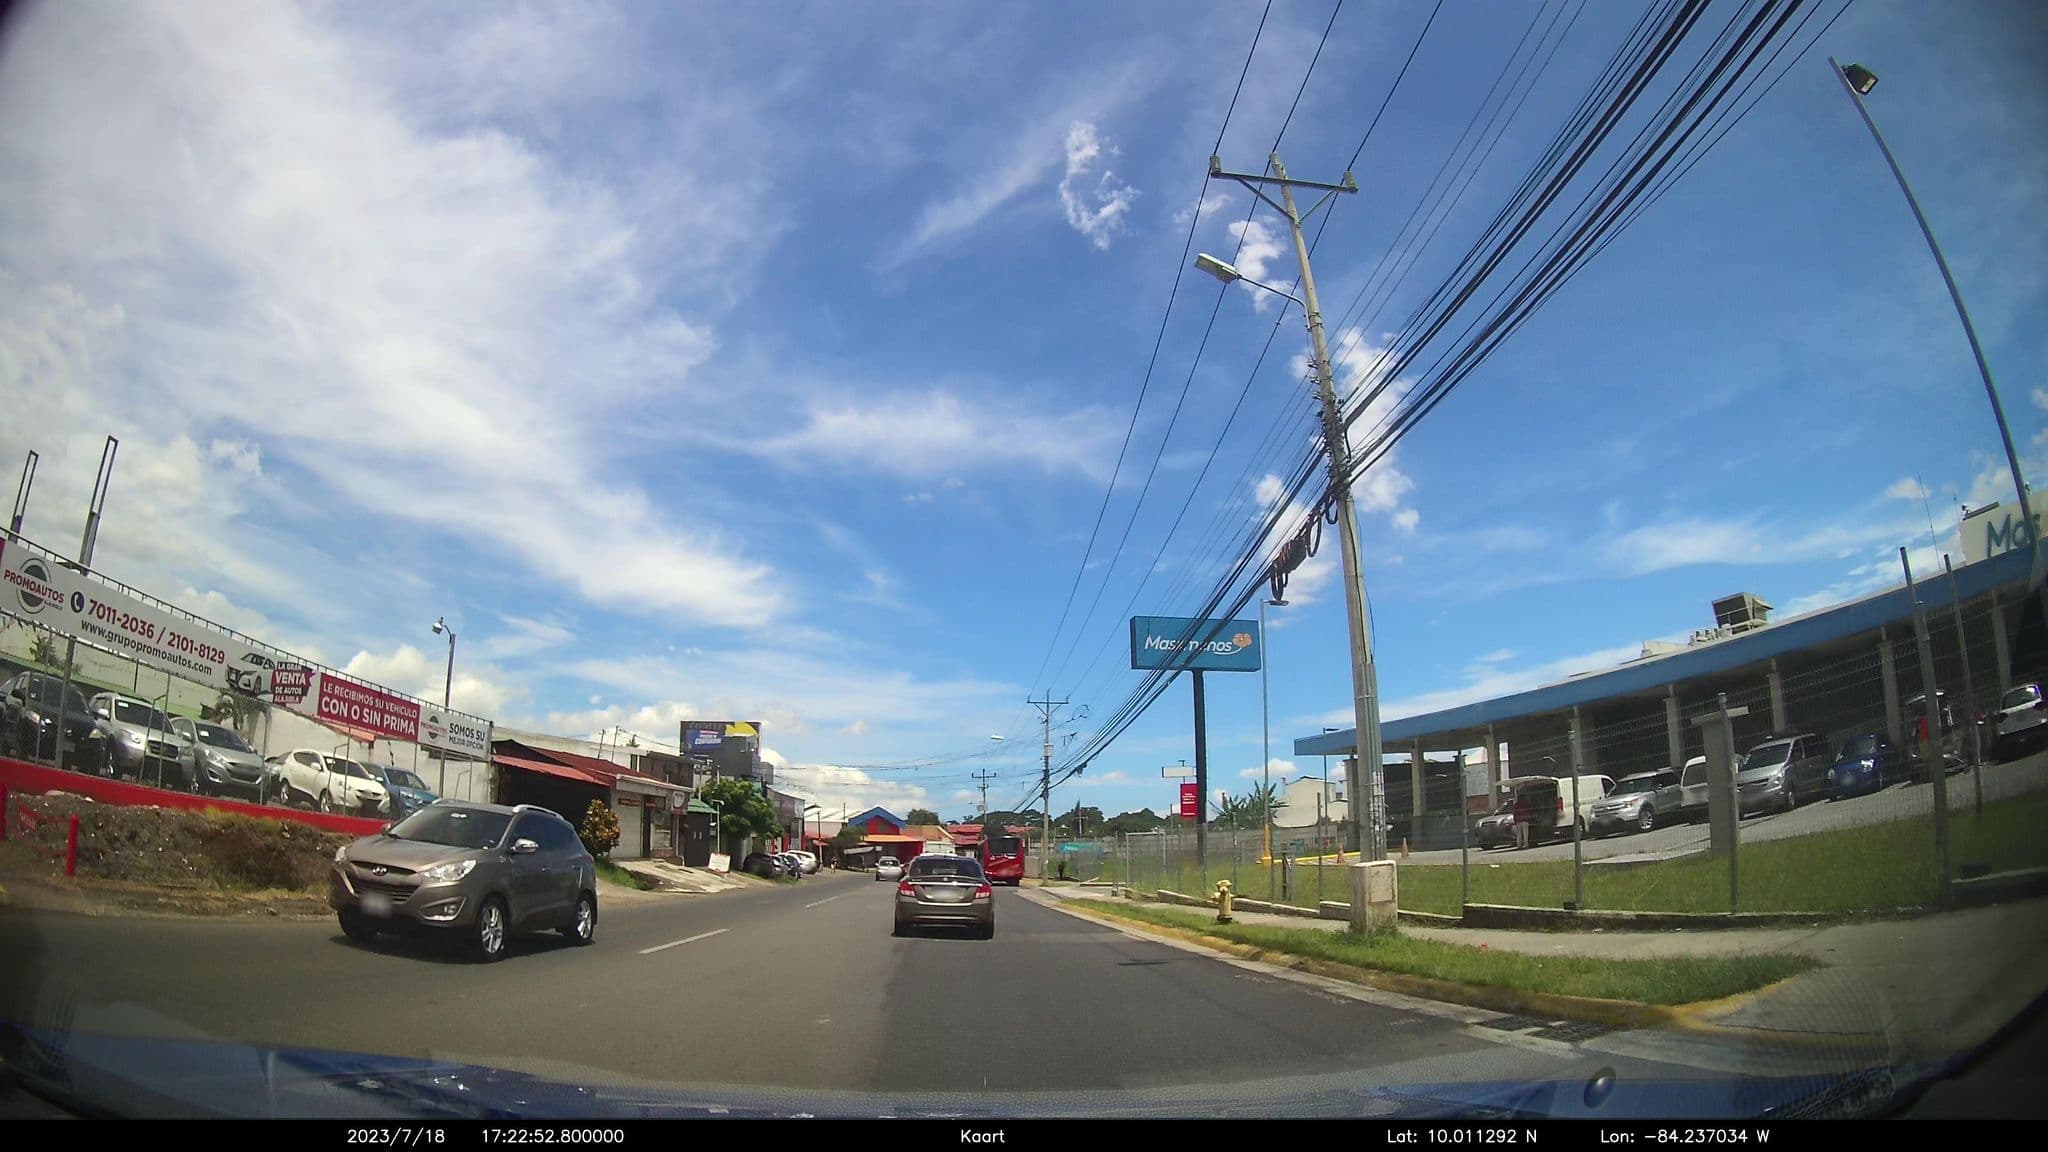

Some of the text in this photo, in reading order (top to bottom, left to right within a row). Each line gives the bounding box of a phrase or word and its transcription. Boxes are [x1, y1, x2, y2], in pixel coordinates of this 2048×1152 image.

[4, 569, 64, 604] PROMOAUTOS
[88, 598, 225, 665] 7011-2036 / 2101-8129
[81, 619, 212, 676] www.grupopromoautos.com
[275, 671, 306, 685] VENTA
[278, 663, 302, 671] LA GRAN
[275, 686, 302, 695] DE AUTOS
[323, 681, 333, 693] LE
[334, 685, 374, 705] RECIBIMOS
[375, 698, 384, 708] SU
[321, 696, 348, 717] CON
[351, 706, 360, 721] O
[362, 708, 381, 727] SIN
[383, 715, 416, 736] PRIMA
[448, 736, 466, 746] MEJOR
[449, 722, 474, 739] SOMOS
[475, 730, 486, 742] SU
